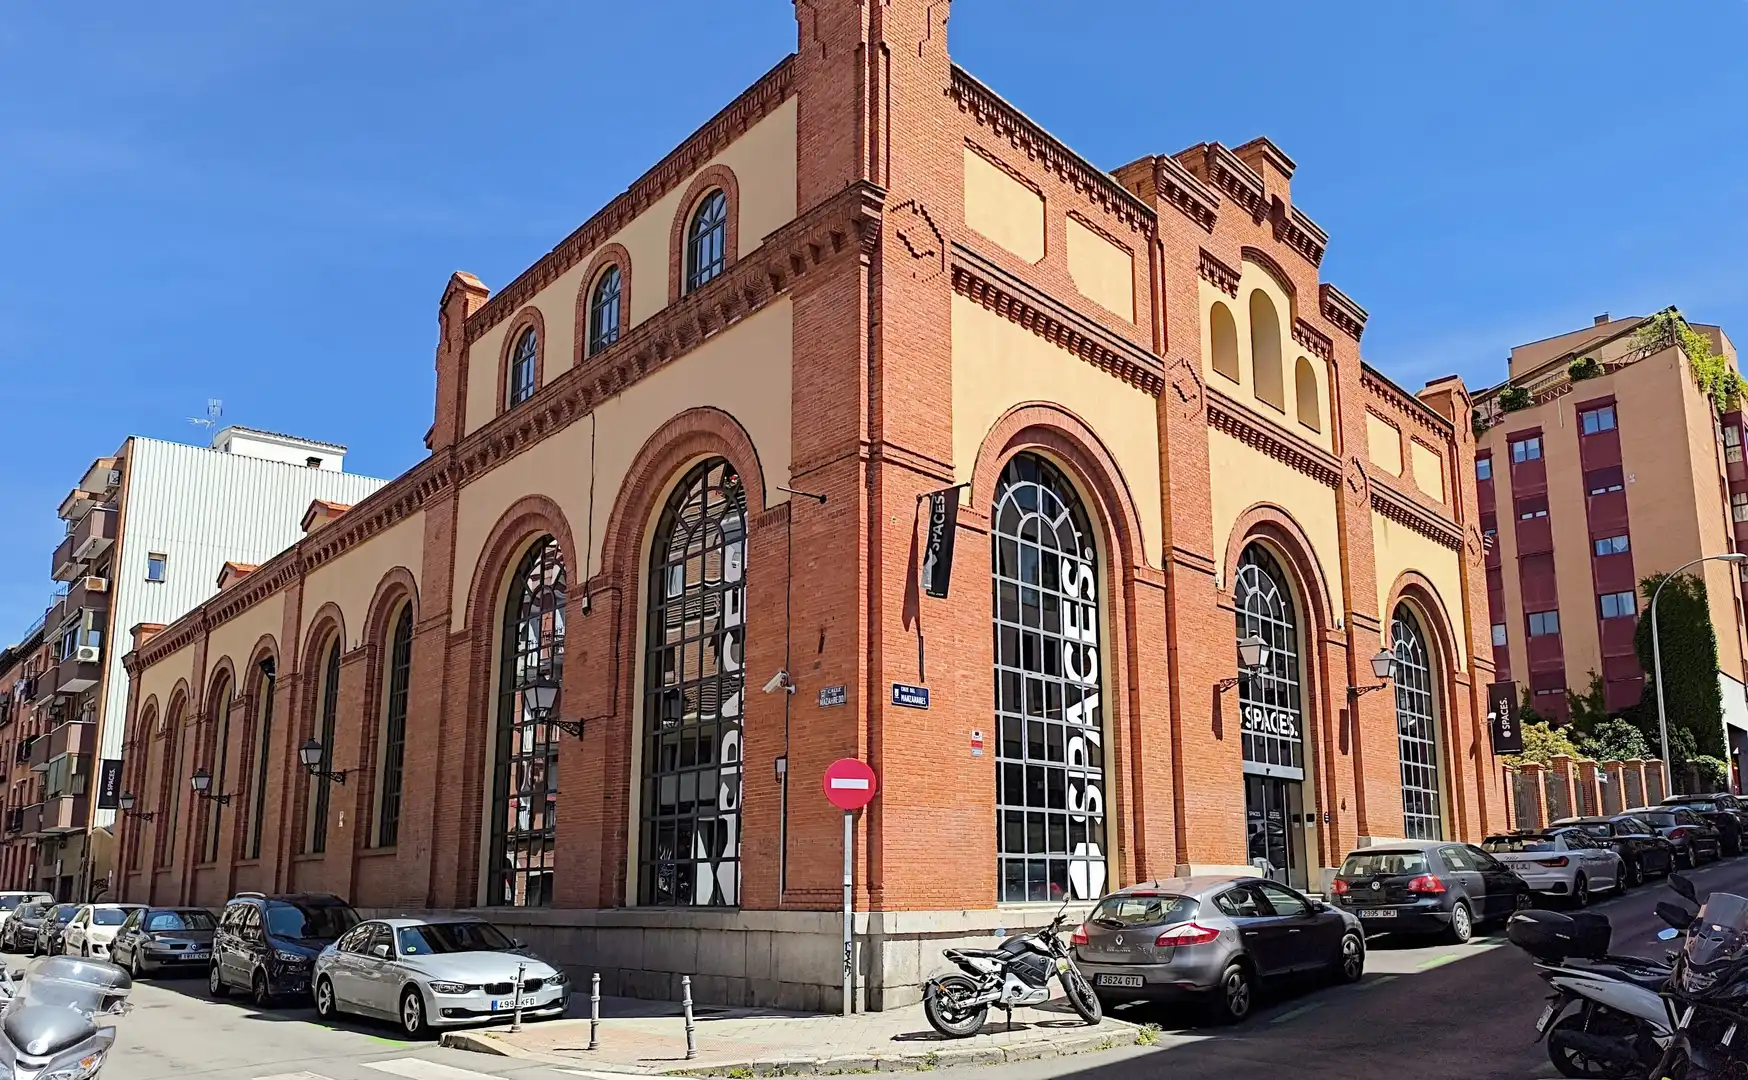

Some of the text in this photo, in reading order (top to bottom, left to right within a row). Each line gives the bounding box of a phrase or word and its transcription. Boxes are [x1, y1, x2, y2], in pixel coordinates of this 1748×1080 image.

[1062, 546, 1103, 825] SPACES.
[1244, 706, 1298, 737] SPACES.
[1499, 697, 1511, 730] SPACES.
[1102, 976, 1141, 987] 3624 GTL
[499, 1000, 517, 1009] 499
